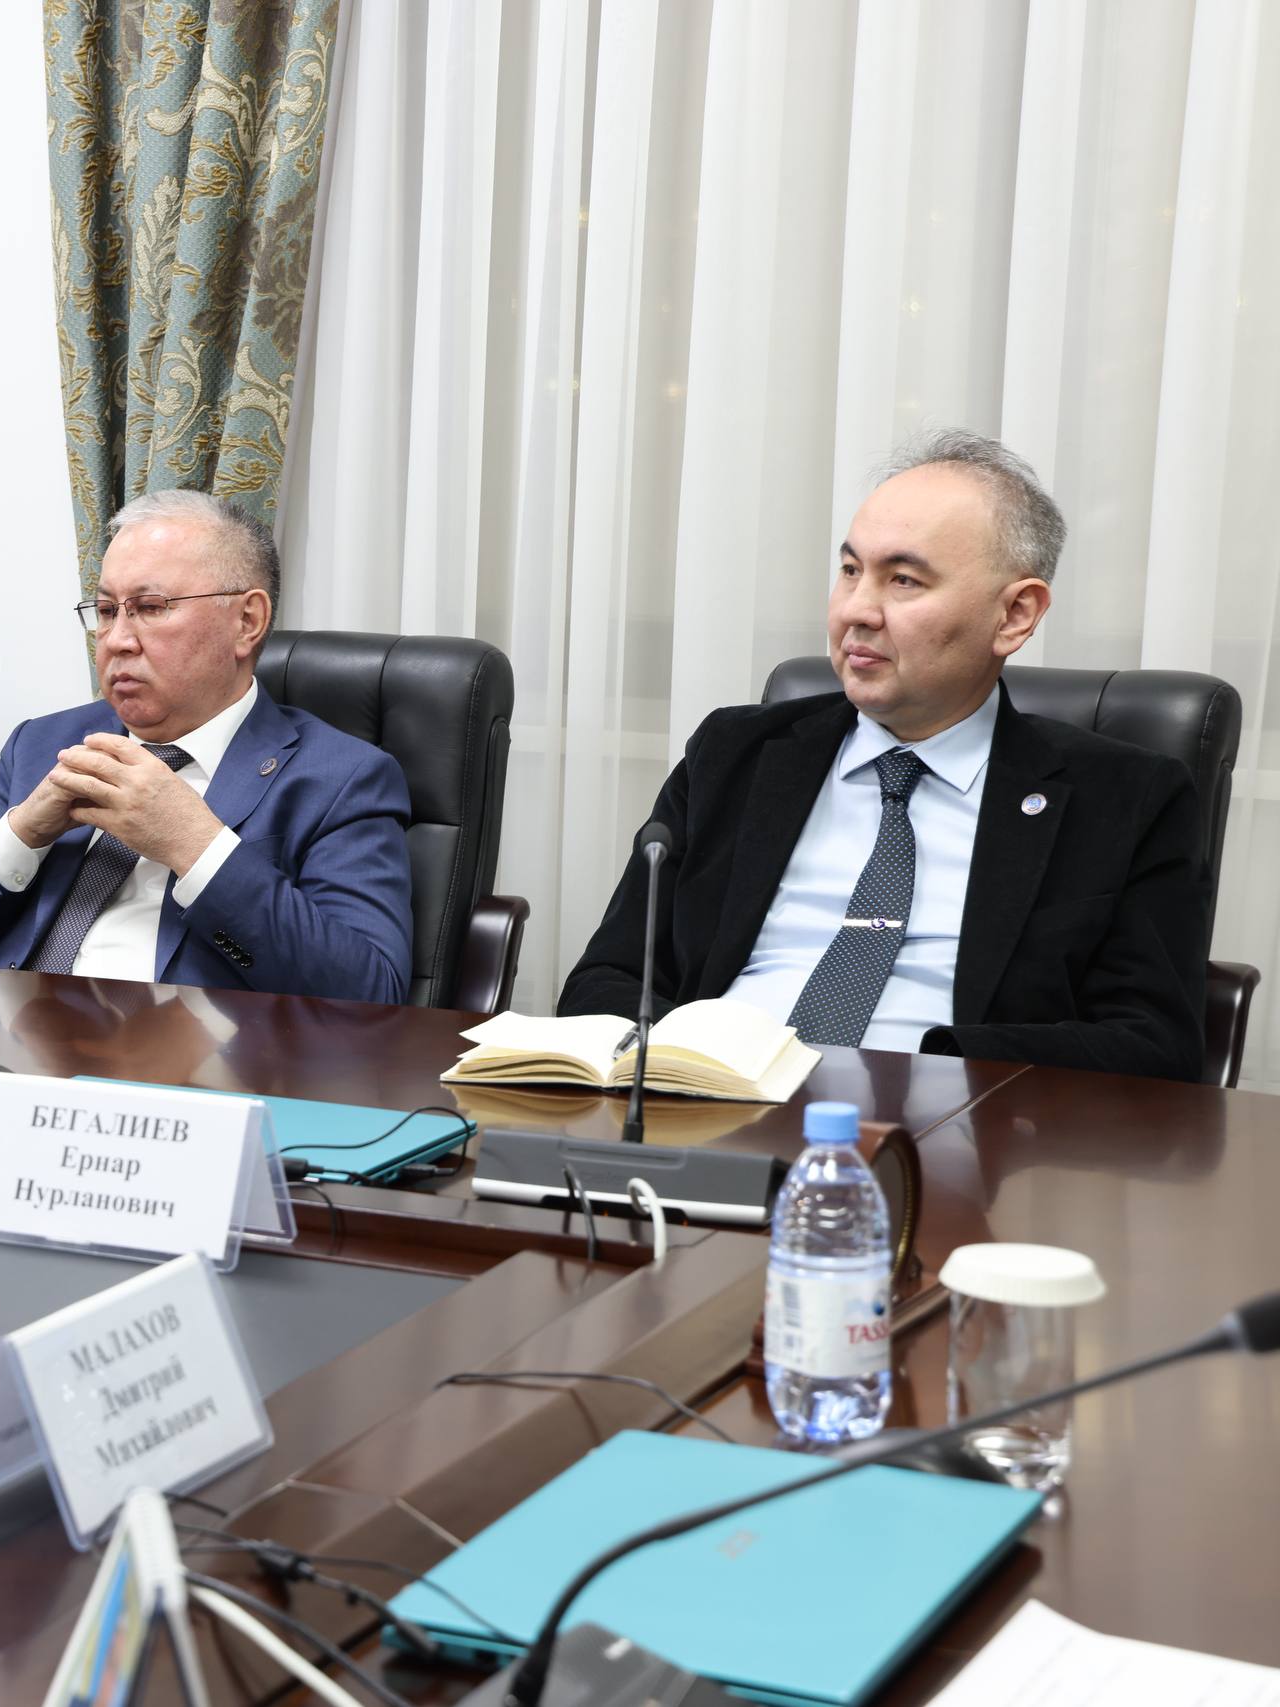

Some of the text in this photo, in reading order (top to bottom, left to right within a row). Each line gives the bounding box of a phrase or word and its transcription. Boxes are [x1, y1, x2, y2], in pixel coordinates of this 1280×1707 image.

[30, 1105, 190, 1143] БЕГАЛИЕВ
[60, 1145, 141, 1181] Ернар
[13, 1178, 175, 1218] Нурланович
[70, 1304, 181, 1377] МАЛАХОВ
[100, 1355, 185, 1421] Дмитрий
[95, 1395, 218, 1470] Михайлович
